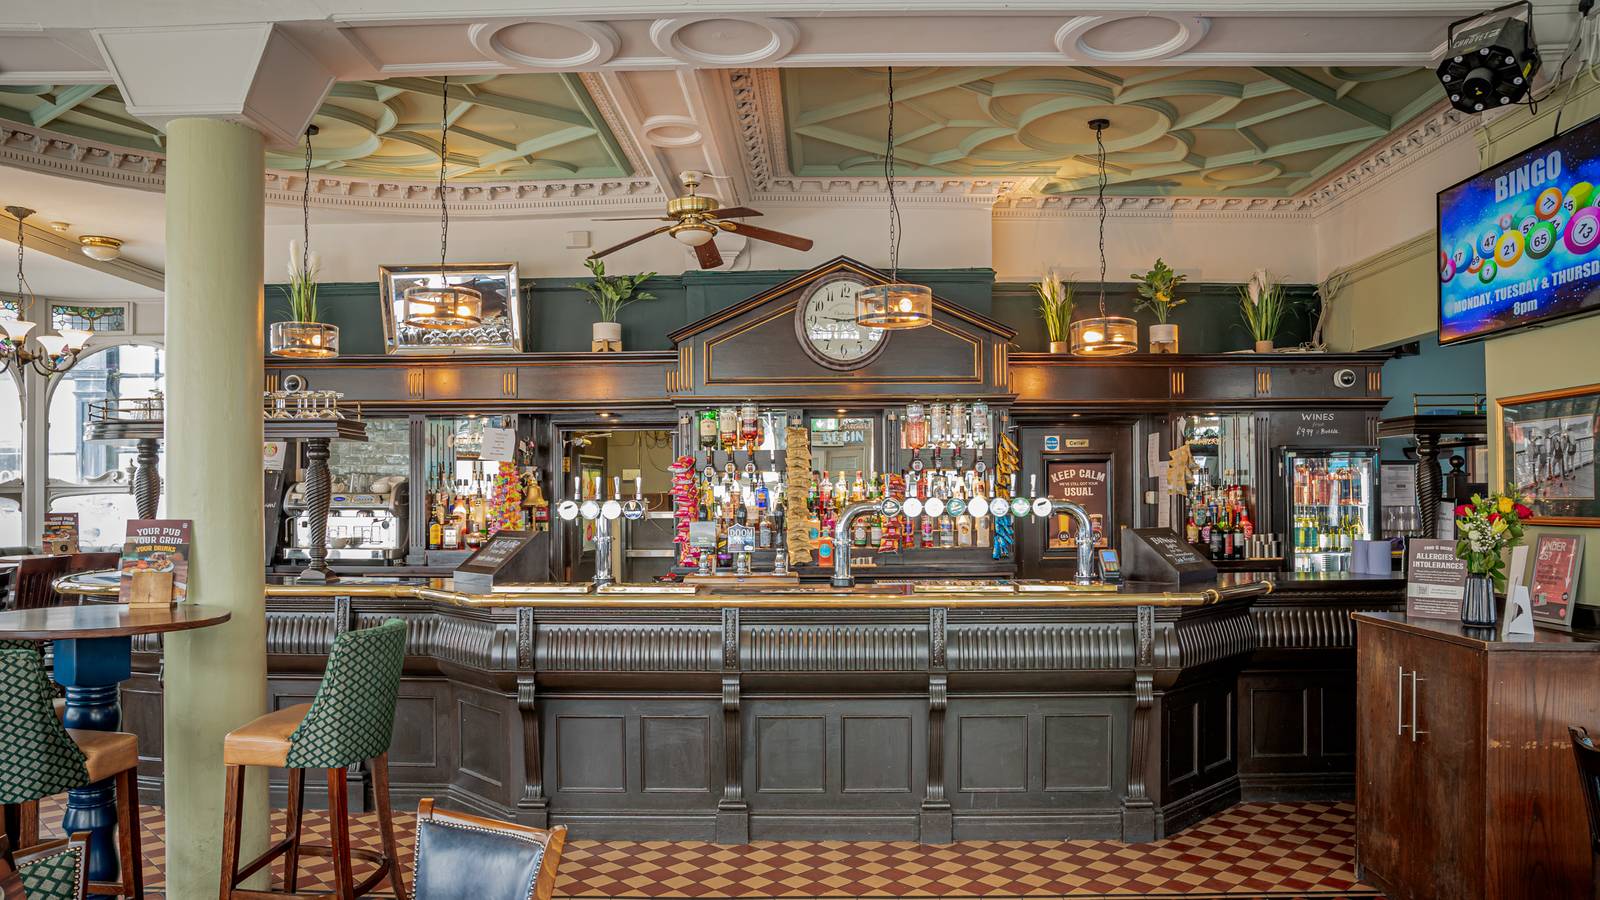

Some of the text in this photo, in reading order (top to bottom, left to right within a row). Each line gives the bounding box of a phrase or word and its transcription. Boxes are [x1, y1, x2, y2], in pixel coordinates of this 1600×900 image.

[1495, 150, 1562, 203] BINGO
[1543, 197, 1555, 209] 77
[1578, 223, 1593, 239] 13
[1484, 235, 1495, 247] 47
[1534, 233, 1547, 247] 65
[1503, 242, 1516, 256] 21
[840, 283, 850, 298] 12
[1453, 260, 1600, 314] MONDAY, TUESDAY & THURSD
[825, 288, 834, 302] 11
[812, 301, 824, 312] 10
[1513, 299, 1538, 316] 8pm
[807, 315, 817, 326] 9
[840, 344, 847, 358] 6
[1301, 413, 1334, 421] WINES
[1051, 469, 1105, 483] KEEP CALM
[1064, 487, 1094, 496] USUAL
[136, 527, 181, 537] YOUR PUB
[730, 529, 753, 537] DOOM
[135, 536, 157, 544] YOUR
[136, 545, 176, 553] YOUR DRINKS
[1542, 541, 1567, 552] UNDER
[1416, 552, 1453, 561] ALLERGIES
[1412, 561, 1464, 569] INTOLERANCES
